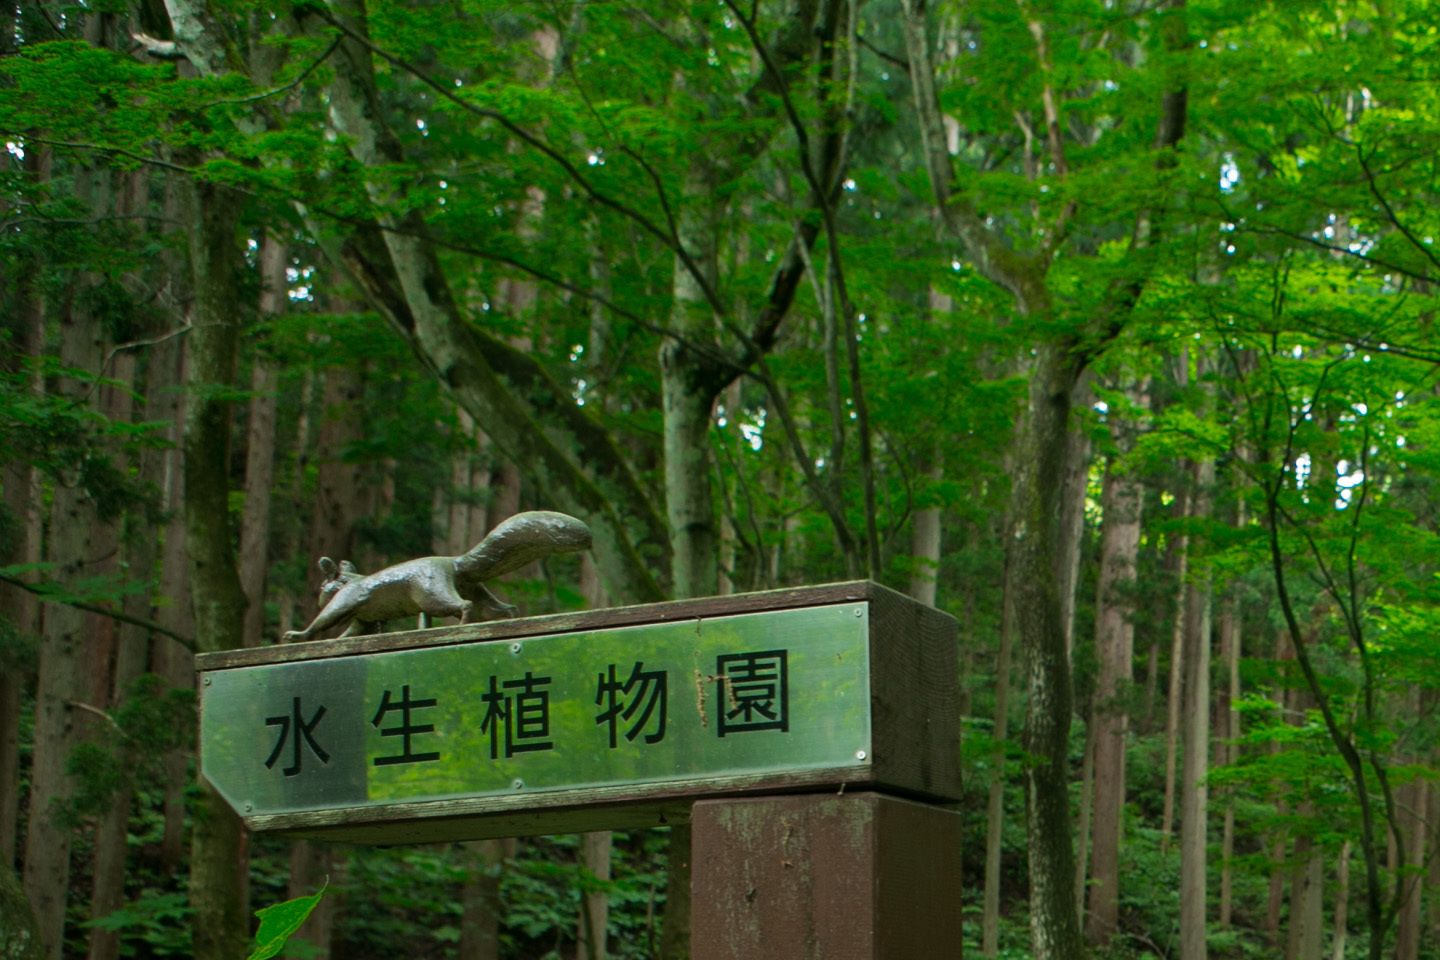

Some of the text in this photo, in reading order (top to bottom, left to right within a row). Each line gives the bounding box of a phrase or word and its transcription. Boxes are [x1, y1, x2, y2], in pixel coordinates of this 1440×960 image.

[264, 648, 790, 777] 水生植物園
